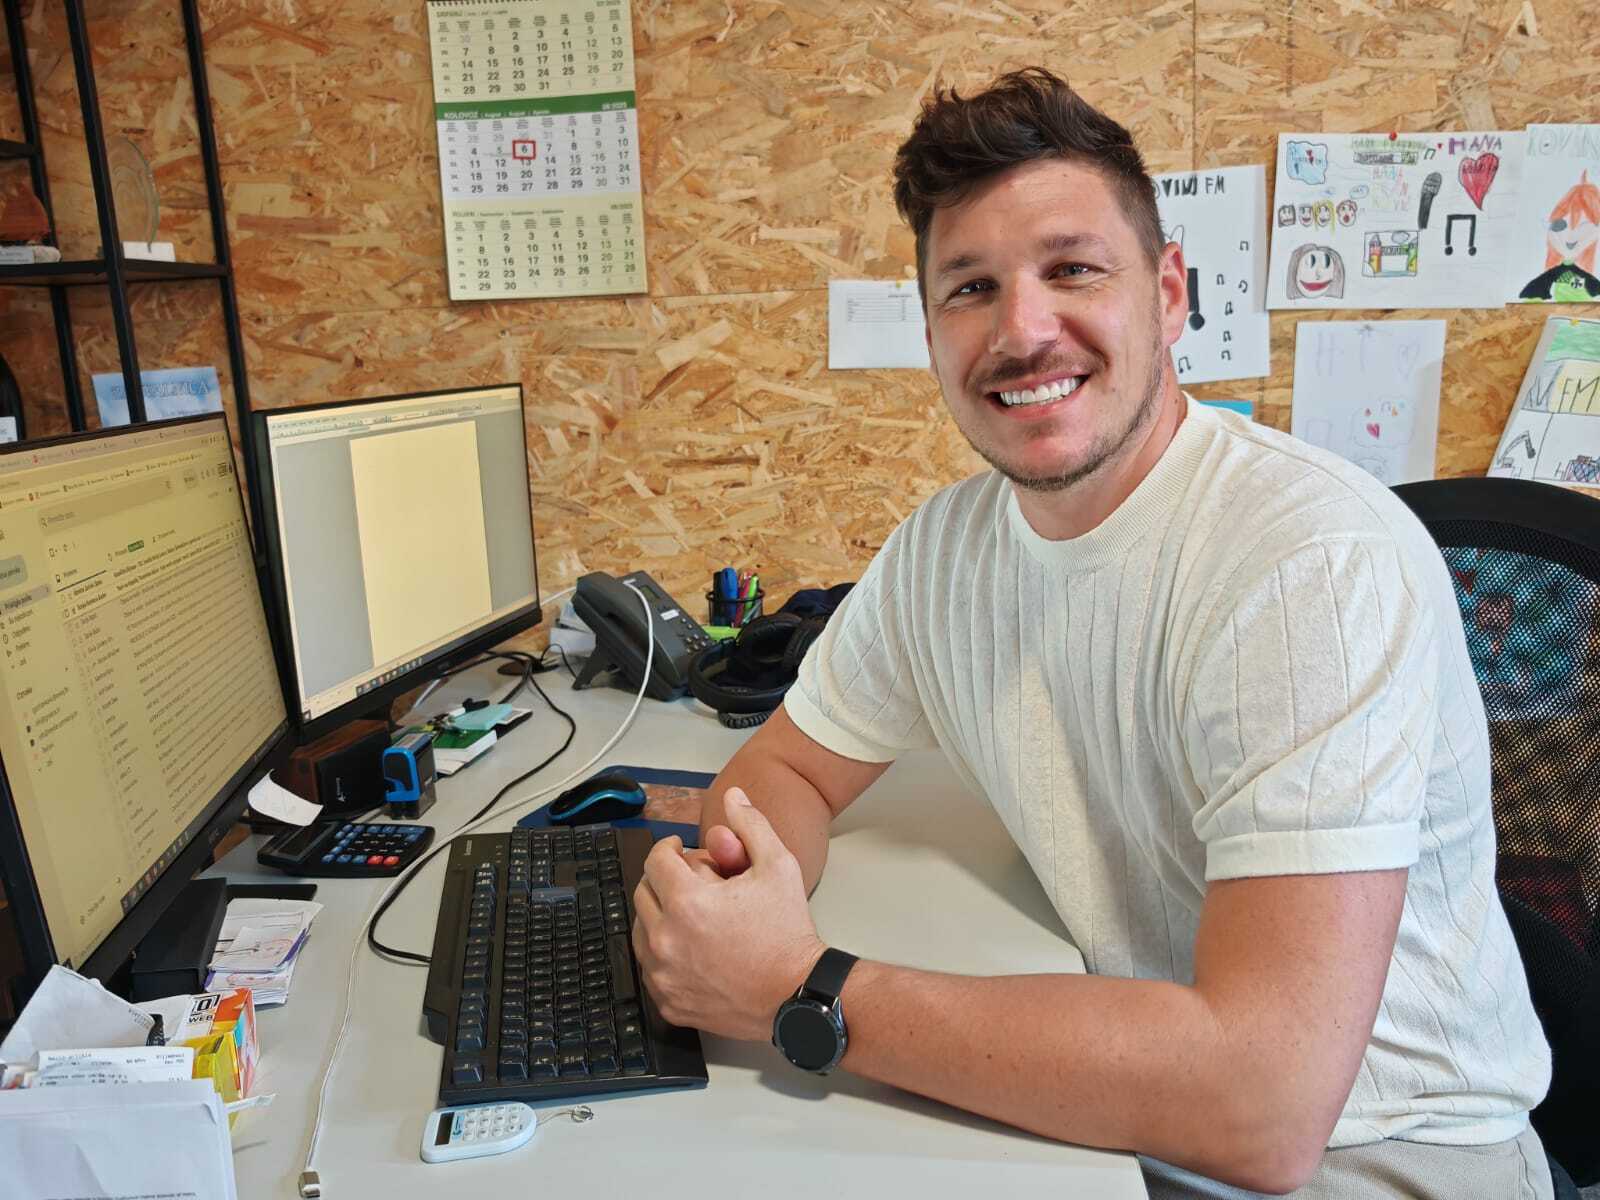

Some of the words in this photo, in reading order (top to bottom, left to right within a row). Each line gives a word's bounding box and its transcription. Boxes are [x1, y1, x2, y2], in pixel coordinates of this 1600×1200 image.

[537, 43, 548, 52] 10
[561, 41, 571, 49] 11
[587, 38, 597, 47] 12
[611, 36, 622, 46] 13
[462, 60, 473, 68] 14
[487, 59, 498, 67] 15
[512, 57, 524, 66] 16
[537, 55, 548, 64] 17
[563, 54, 573, 62] 18
[587, 52, 599, 60] 19
[612, 49, 623, 59] 20
[462, 73, 473, 81] 21
[488, 71, 499, 80] 22
[513, 70, 524, 79] 23
[538, 68, 549, 77] 24
[563, 66, 574, 75] 25
[612, 62, 623, 72] 27
[464, 86, 475, 94] 28
[489, 84, 501, 93] 29
[514, 83, 526, 92] 30
[539, 81, 549, 90] 31
[618, 137, 628, 147] 10
[1448, 134, 1503, 155] HANA
[470, 160, 480, 168] 11
[496, 158, 506, 167] 12
[520, 157, 531, 166] 13
[546, 156, 556, 164] 14
[570, 154, 581, 163] 15
[619, 150, 629, 159] 17
[471, 172, 482, 180] 18
[496, 171, 508, 180] 19
[521, 169, 532, 178] 20
[545, 168, 556, 177] 21
[570, 167, 582, 176] 22
[596, 165, 606, 174] 23
[619, 164, 630, 172] 24
[472, 185, 483, 193] 25
[497, 183, 509, 192] 26
[522, 182, 533, 191] 27
[547, 181, 558, 189] 28
[571, 179, 583, 188] 29
[620, 176, 630, 185] 31
[1205, 174, 1225, 195] FM
[527, 244, 538, 252] 10
[552, 243, 562, 251] 11
[577, 241, 587, 250] 12
[601, 239, 611, 249] 13
[624, 239, 634, 247] 14
[477, 258, 489, 267] 15
[503, 257, 514, 265] 16
[528, 256, 539, 265] 17
[553, 255, 564, 263] 18
[578, 254, 588, 263] 19
[601, 252, 612, 261] 20
[624, 251, 634, 260] 21
[478, 270, 490, 279] 22
[504, 269, 515, 278] 23
[529, 269, 540, 277] 24
[554, 267, 565, 276] 25
[578, 266, 589, 275] 26
[602, 264, 613, 273] 27
[625, 264, 635, 272] 28
[479, 282, 491, 291] 29
[505, 281, 516, 290] 30
[1558, 375, 1600, 413] FM
